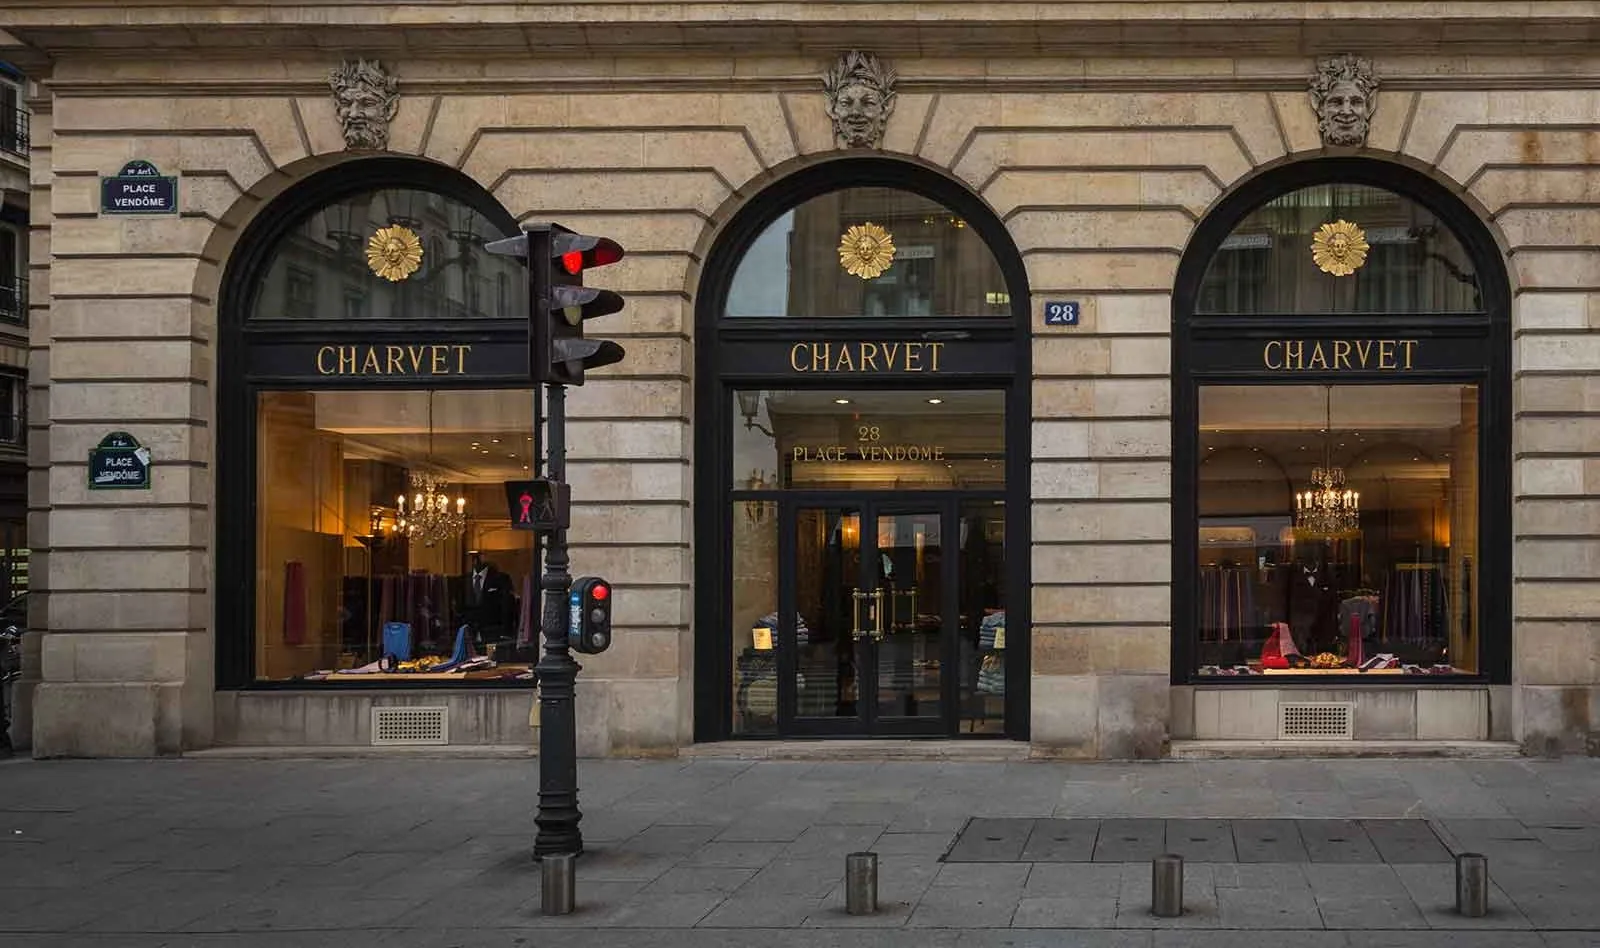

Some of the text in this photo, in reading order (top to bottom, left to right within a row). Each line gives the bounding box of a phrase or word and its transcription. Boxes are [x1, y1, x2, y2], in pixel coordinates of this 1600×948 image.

[123, 185, 156, 193] PLACE
[114, 196, 166, 206] VENDÔME
[1050, 304, 1074, 321] 28
[317, 345, 472, 375] CHARVET
[791, 342, 945, 372] CHARVET
[1264, 340, 1419, 370] CHARVET
[858, 426, 881, 441] 28
[793, 446, 945, 461] PLACE VENDOME
[105, 457, 133, 467] PLACE
